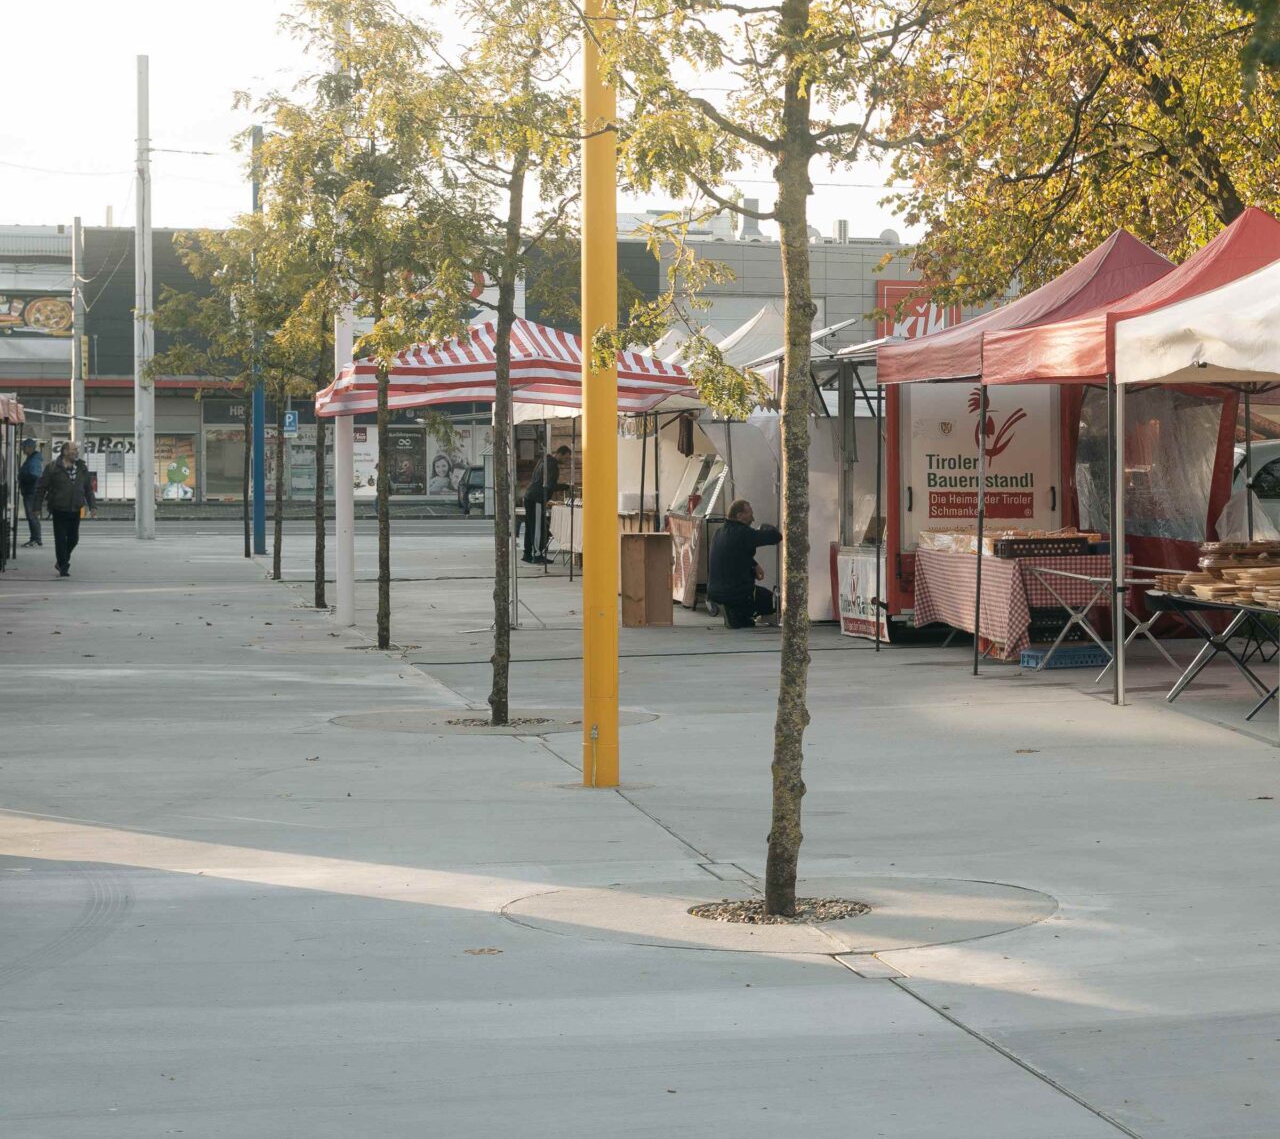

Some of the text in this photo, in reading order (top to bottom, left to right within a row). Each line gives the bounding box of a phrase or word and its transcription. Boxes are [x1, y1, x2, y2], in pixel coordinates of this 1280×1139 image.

[286, 414, 293, 426] P
[52, 437, 136, 454] aaBox
[926, 454, 979, 470] Tiroler
[931, 494, 1031, 504] Die Heima der Tiroler
